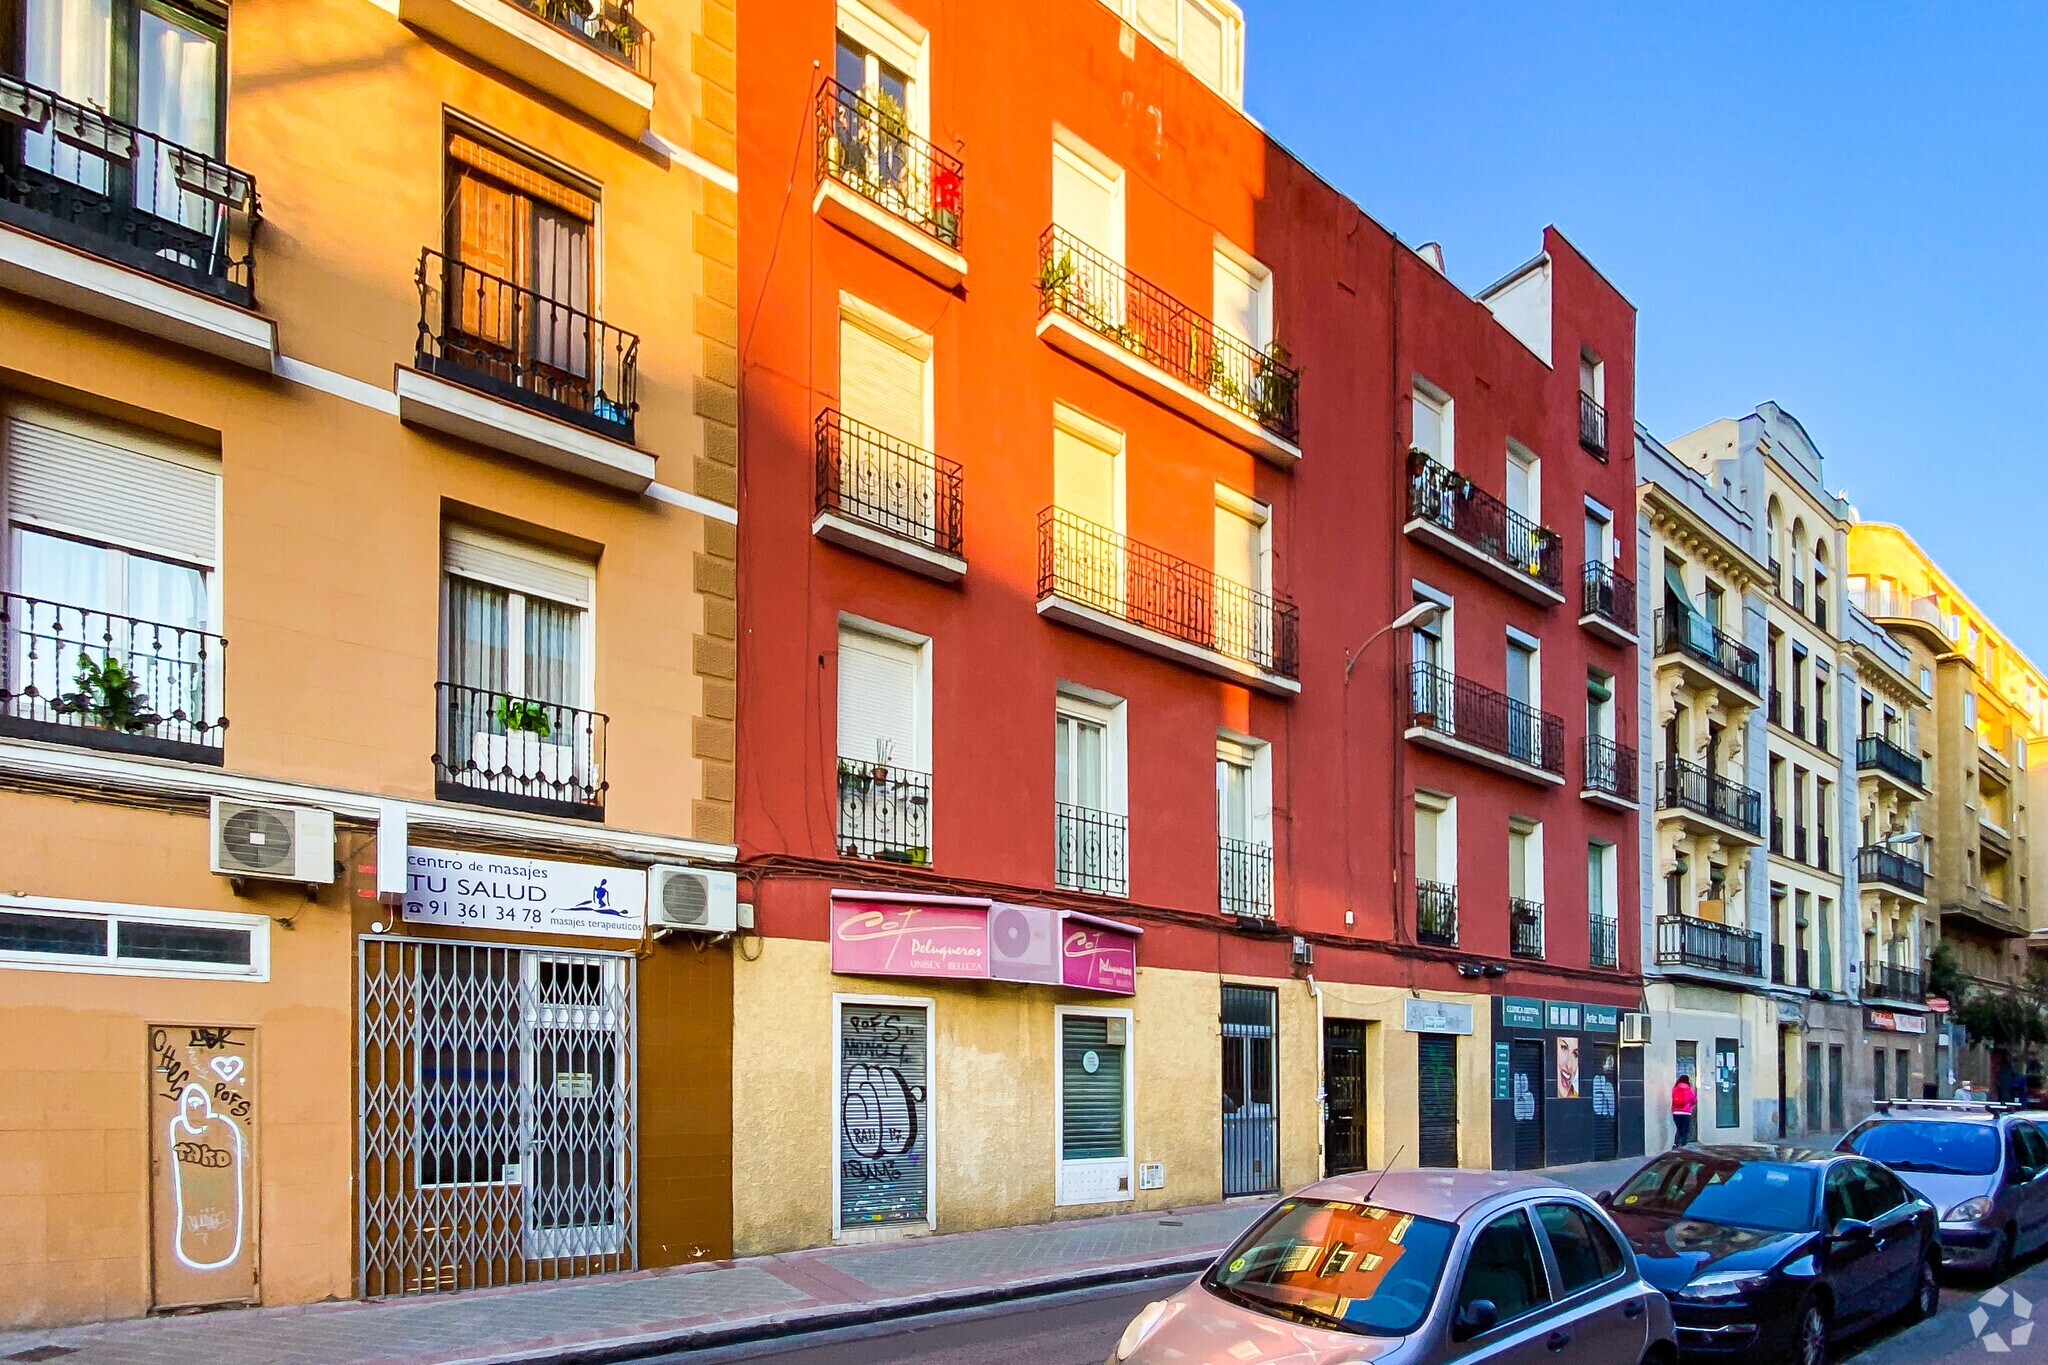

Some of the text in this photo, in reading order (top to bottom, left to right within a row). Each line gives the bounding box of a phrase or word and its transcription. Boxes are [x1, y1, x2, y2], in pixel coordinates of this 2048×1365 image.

[407, 855, 548, 880] centro de masajes
[407, 873, 547, 901] TU SALUD
[429, 900, 541, 923] 91 361 34 78
[550, 916, 585, 928] masajes
[911, 938, 982, 961] Peluqueros
[911, 960, 982, 971] UNISEX BELLEZA
